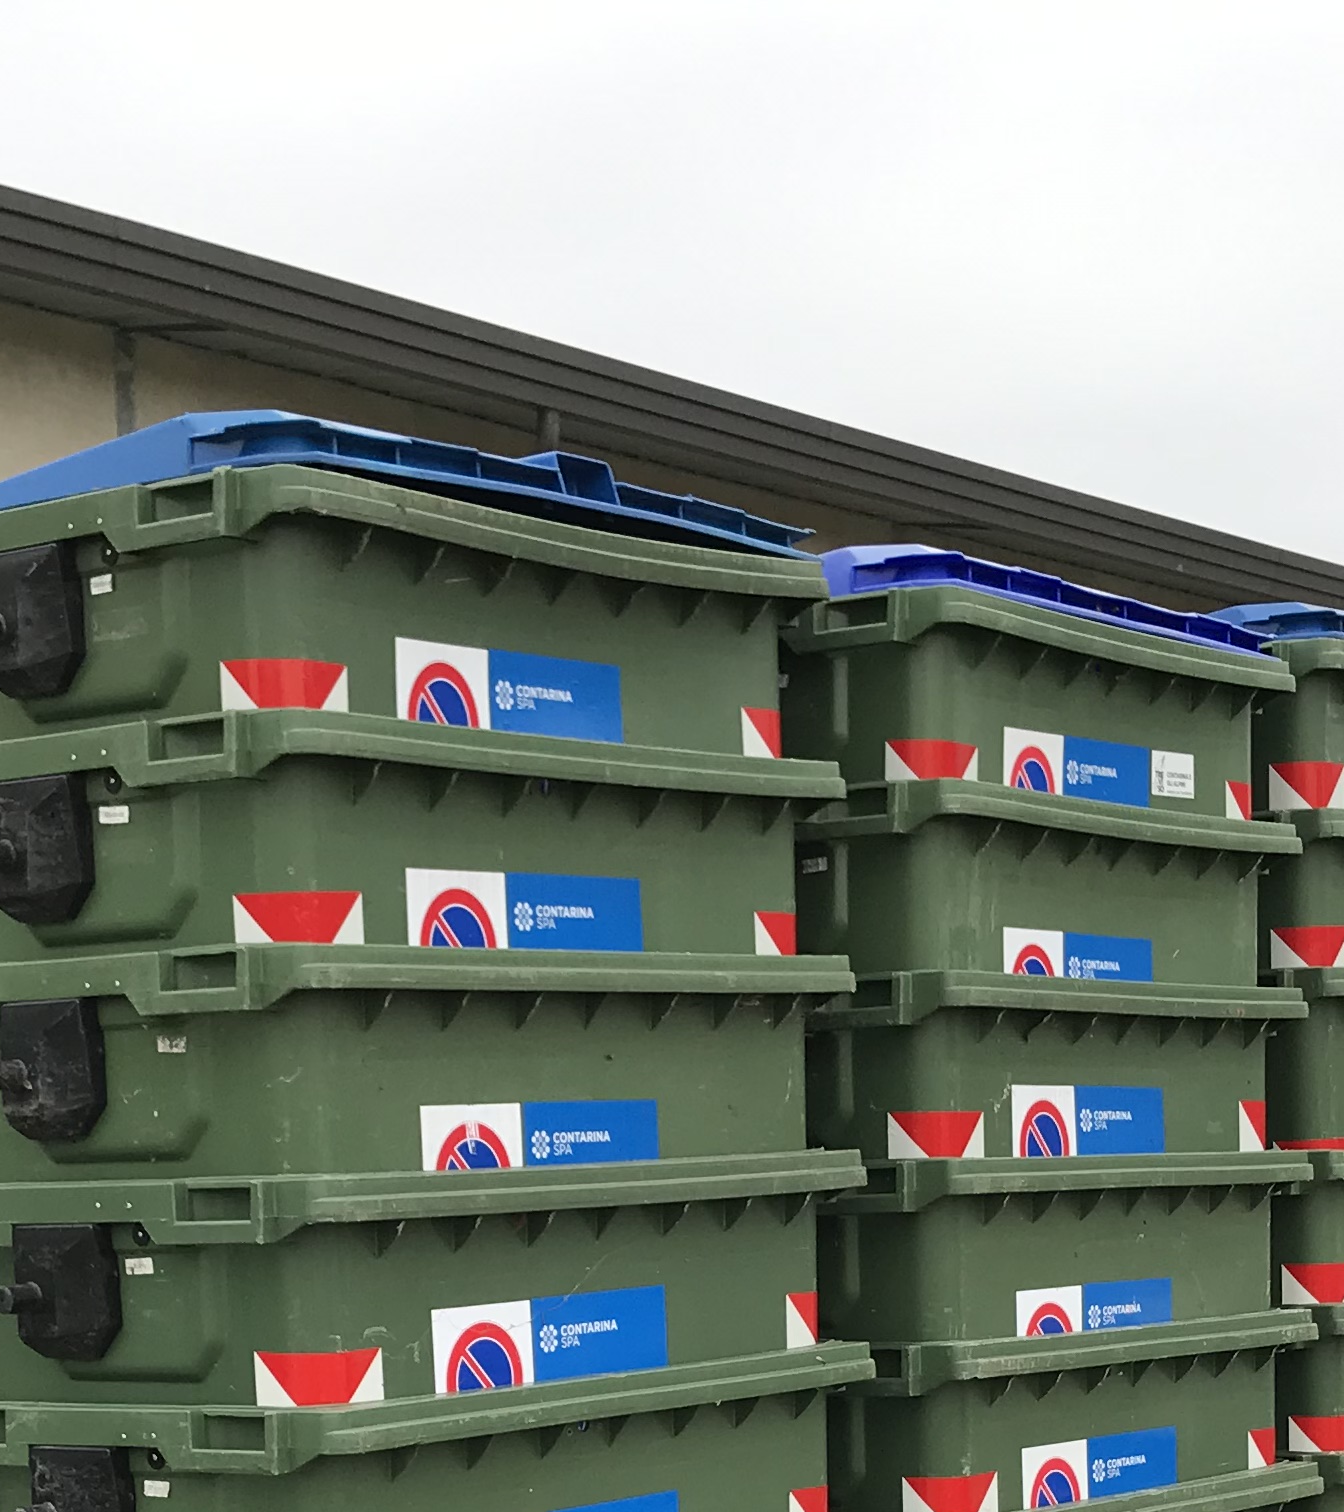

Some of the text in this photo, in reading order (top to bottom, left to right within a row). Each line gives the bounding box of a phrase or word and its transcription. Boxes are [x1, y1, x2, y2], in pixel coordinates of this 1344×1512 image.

[516, 685, 572, 703] CONTARINA
[516, 698, 537, 711] SPA
[1079, 764, 1117, 778] CONTARINA
[535, 905, 594, 919] CONTARINA
[535, 917, 556, 930] SPA
[1082, 959, 1119, 971] CONTARINA
[1093, 1109, 1131, 1120] CONTARINA
[552, 1131, 610, 1143] CONTARINA
[552, 1143, 574, 1156] SPA
[1102, 1303, 1141, 1315] CONTARINA
[560, 1319, 618, 1335] CONTARINA
[560, 1336, 580, 1349] SPA
[1106, 1455, 1146, 1468] CONTARINA
